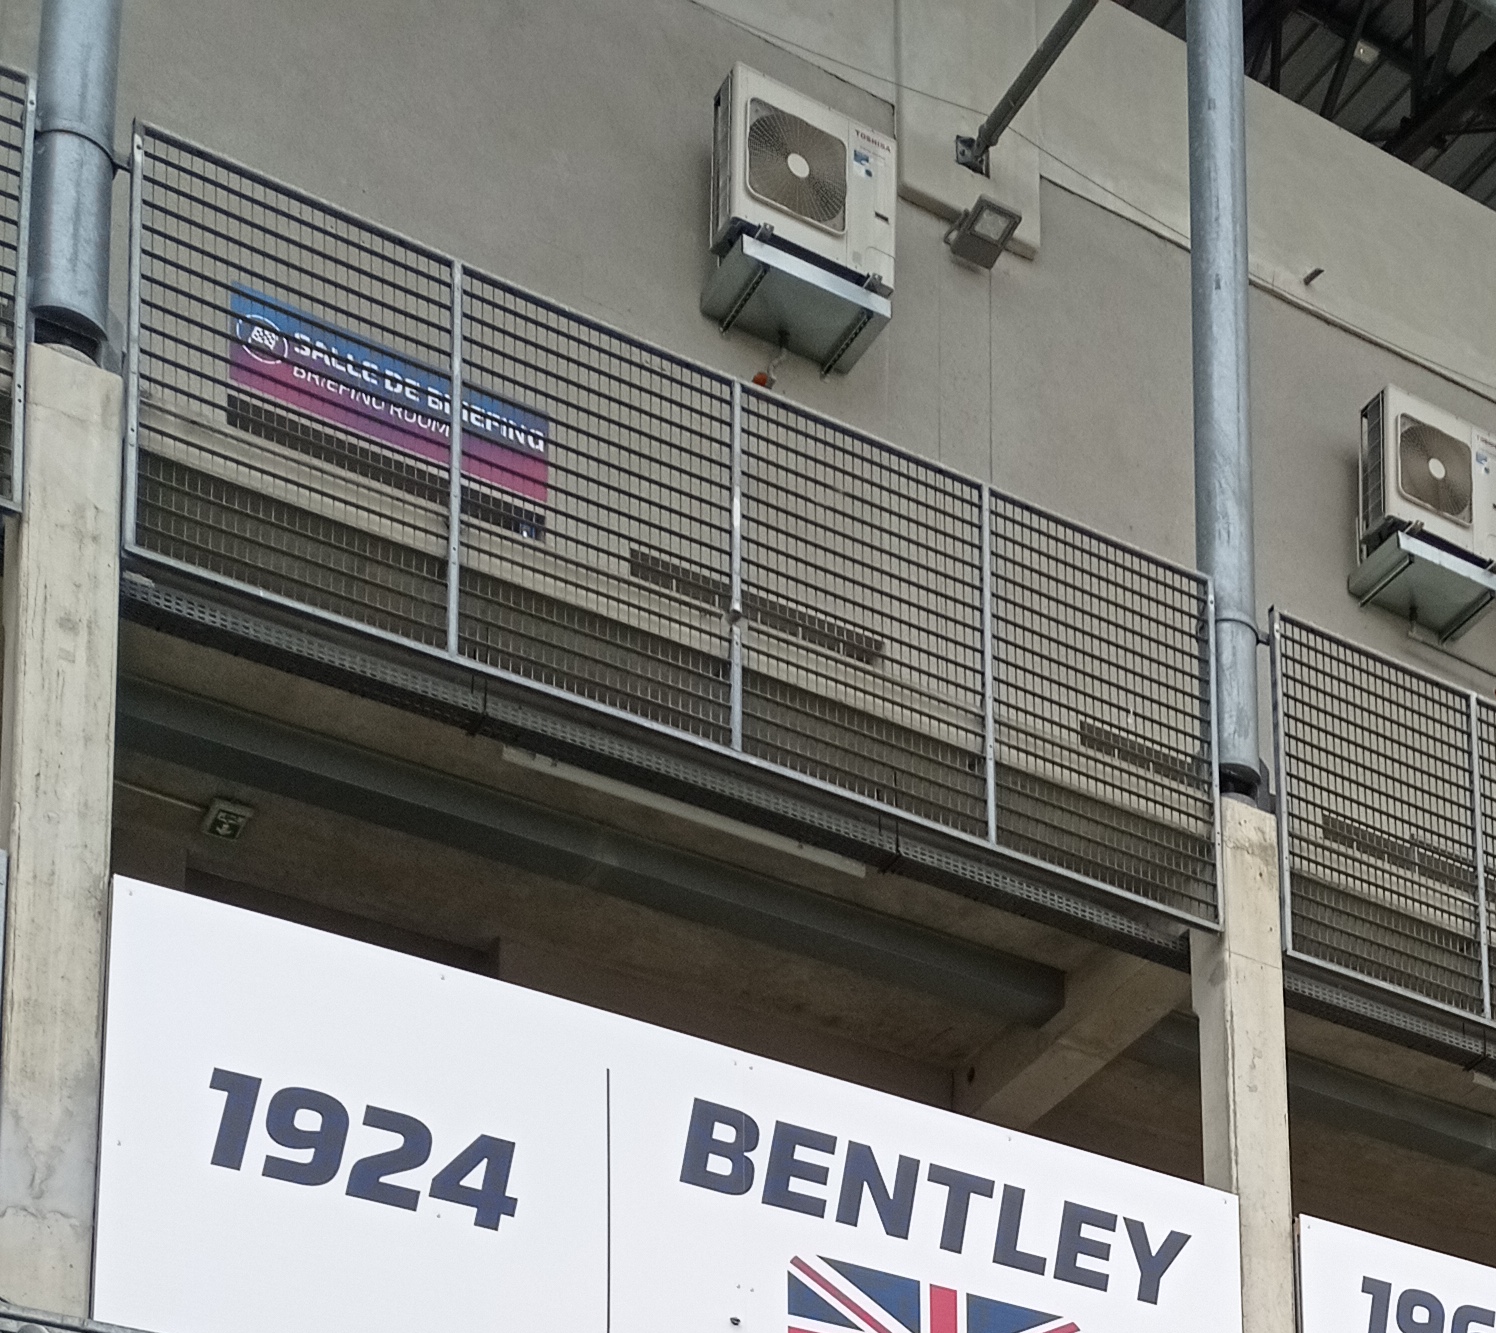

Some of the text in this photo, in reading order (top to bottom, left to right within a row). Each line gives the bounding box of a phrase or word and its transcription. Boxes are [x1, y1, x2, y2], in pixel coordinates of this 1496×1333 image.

[294, 332, 379, 385] SALLE
[384, 368, 421, 402] DE
[208, 1066, 519, 1230] 1924
[679, 1097, 1191, 1305] BENTLEY
